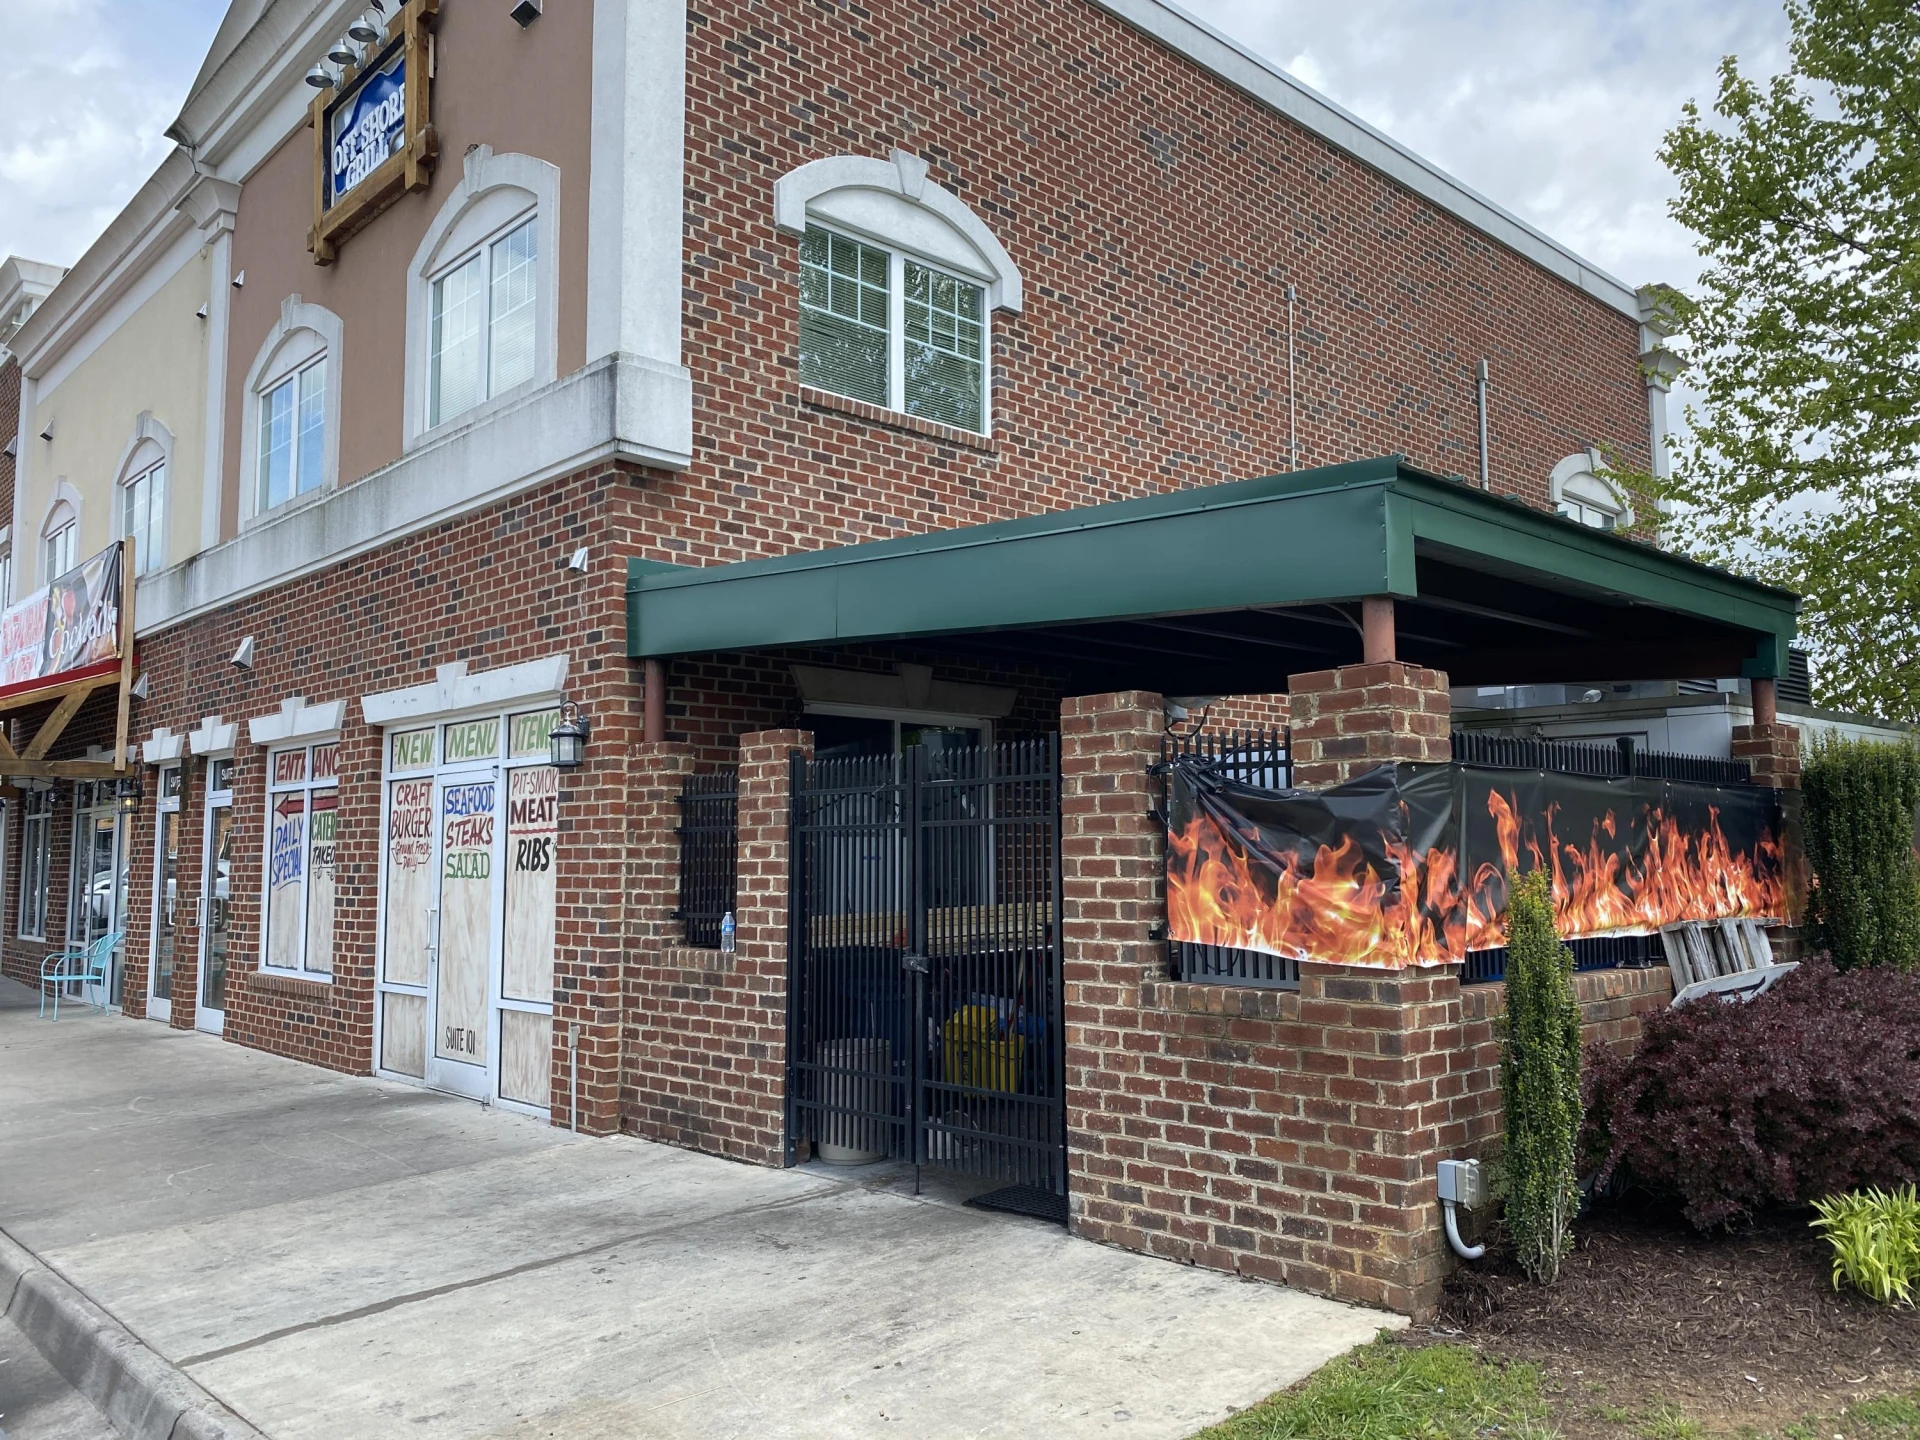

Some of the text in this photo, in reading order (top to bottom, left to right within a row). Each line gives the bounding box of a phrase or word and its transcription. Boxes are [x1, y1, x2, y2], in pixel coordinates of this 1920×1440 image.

[333, 82, 405, 175] OFF SHORE
[345, 133, 389, 190] GRILL
[49, 599, 112, 659] Cocktails
[397, 733, 434, 766] NEW
[448, 721, 499, 758] MENU
[396, 782, 433, 807] CRAFT
[445, 785, 495, 816] SEAFOOD
[509, 796, 558, 825] MEAT
[274, 816, 304, 854] DAILY
[390, 807, 433, 841] BURGER
[445, 816, 495, 849] STEAKS
[444, 852, 491, 880] SALAD
[515, 836, 551, 872] RIBS
[445, 1026, 464, 1051] SUITE
